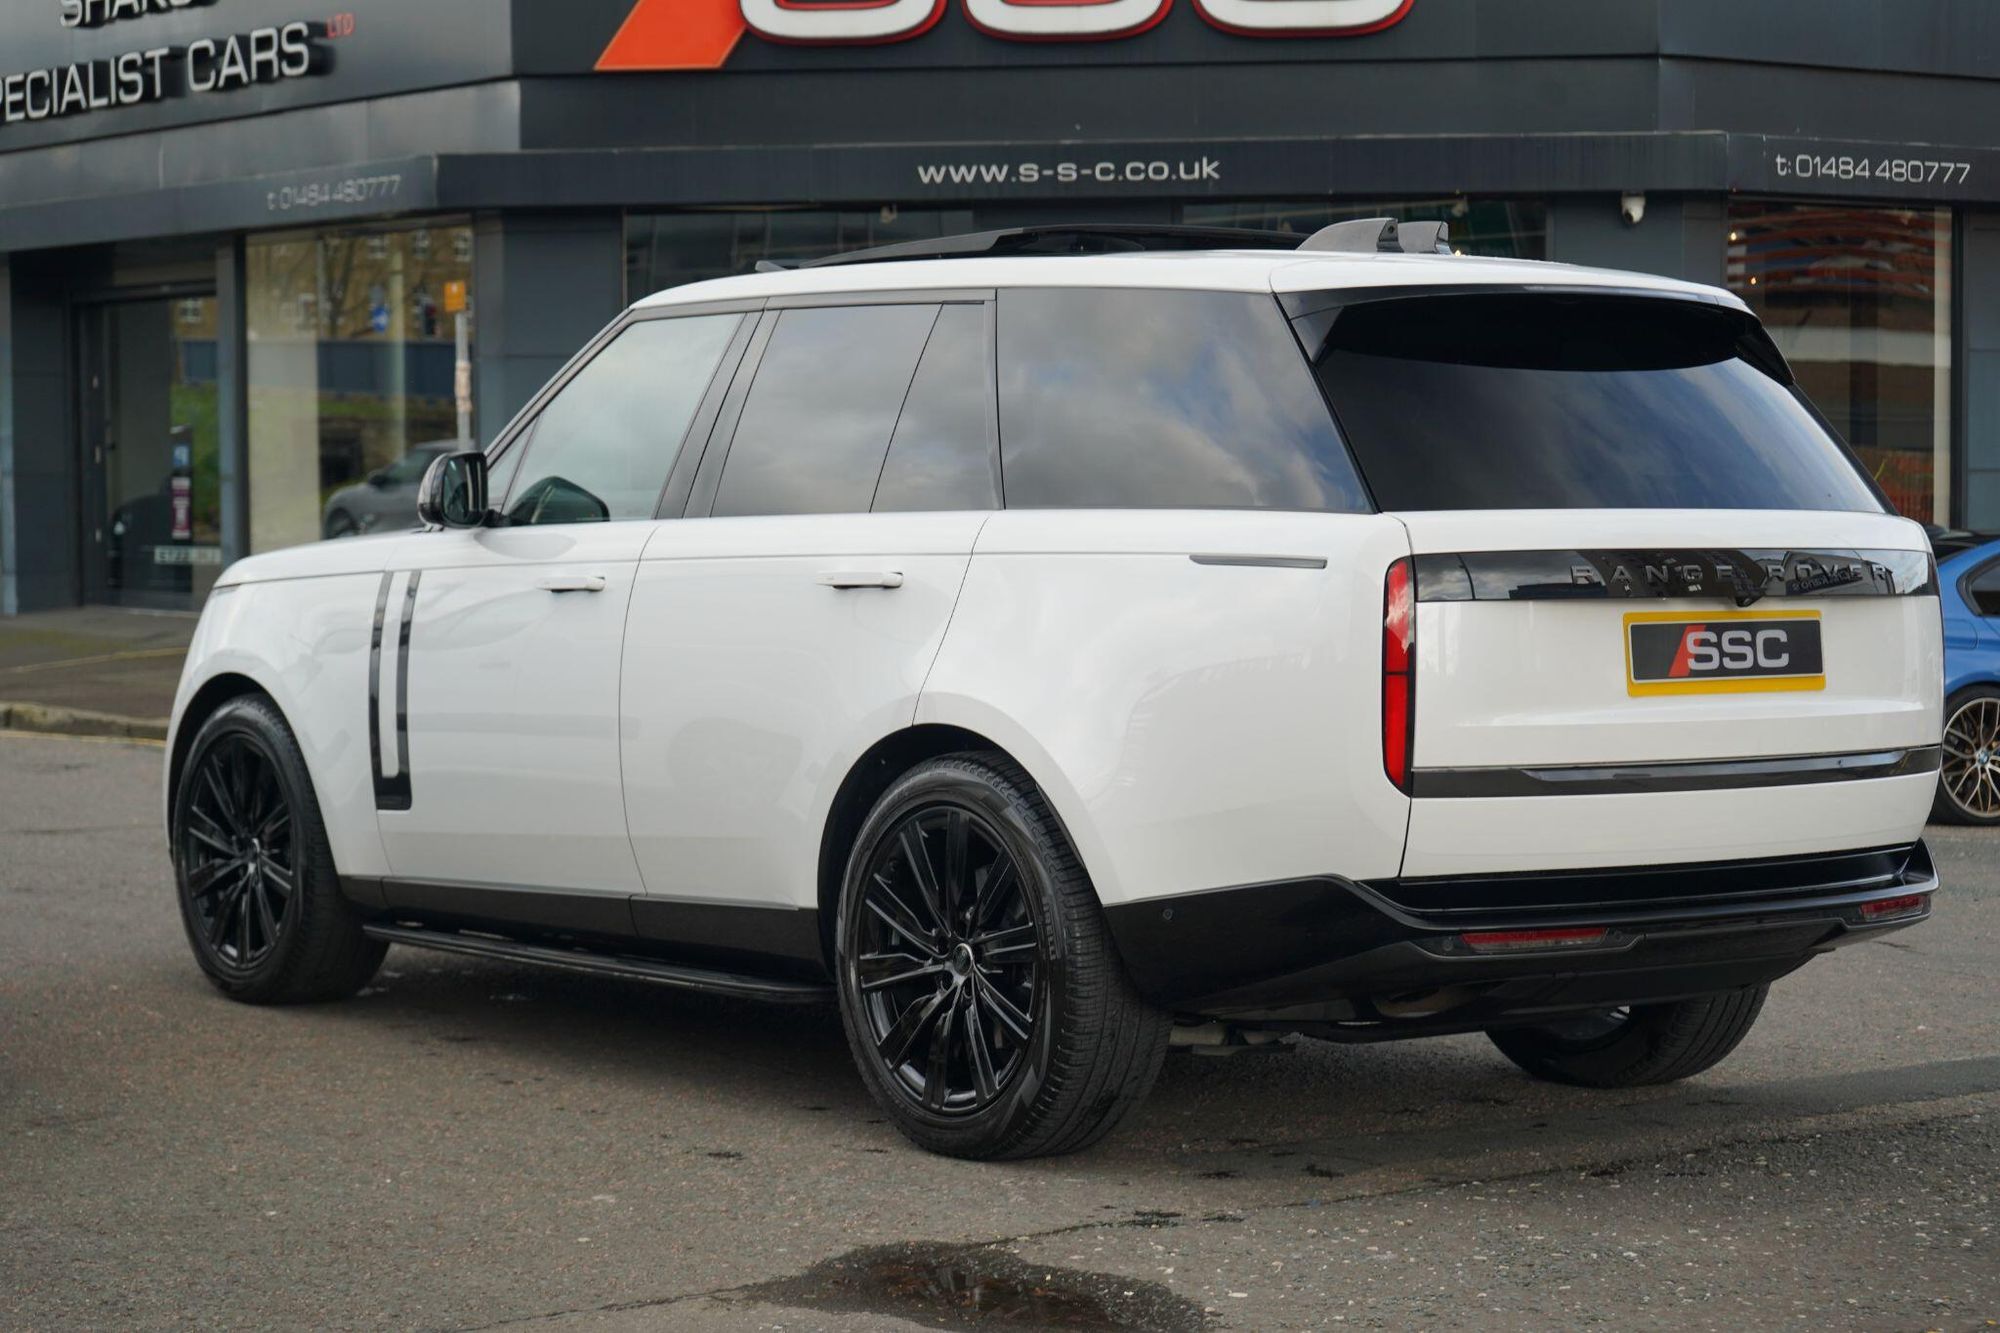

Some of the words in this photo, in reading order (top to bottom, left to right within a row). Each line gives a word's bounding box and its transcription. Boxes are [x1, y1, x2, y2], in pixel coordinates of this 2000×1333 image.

[0, 47, 169, 122] ECIALIST
[187, 21, 309, 92] CARS
[327, 12, 355, 39] LTD
[917, 156, 1221, 183] www.s-s-c.co.uk
[1875, 159, 1971, 184] 480777
[1570, 565, 1733, 585] RANGE
[1766, 564, 1887, 582] ROVER
[1686, 629, 1789, 670] SSC
